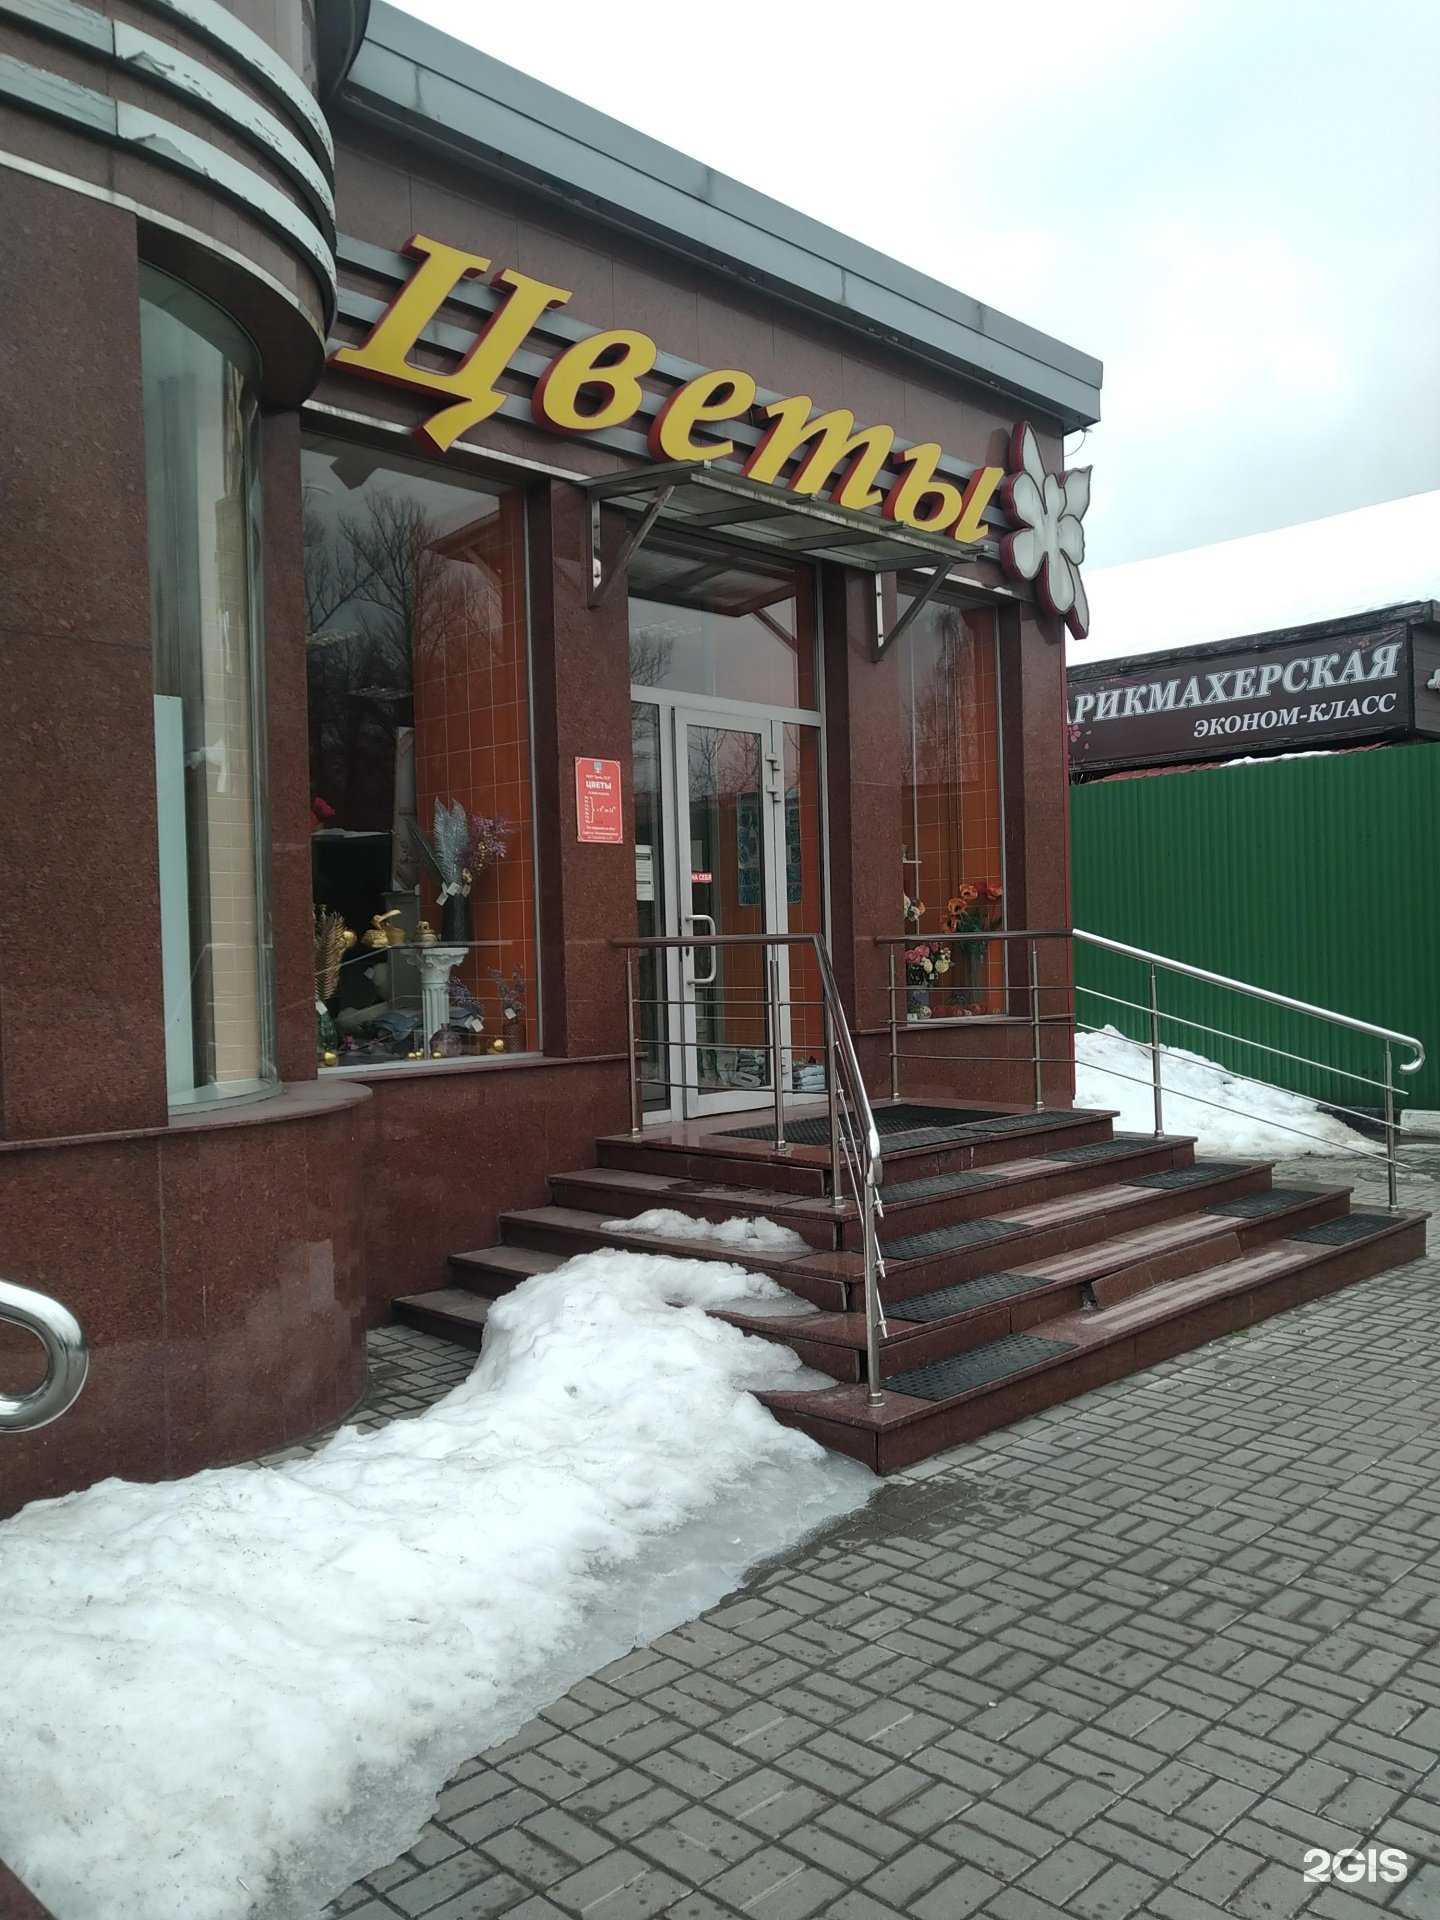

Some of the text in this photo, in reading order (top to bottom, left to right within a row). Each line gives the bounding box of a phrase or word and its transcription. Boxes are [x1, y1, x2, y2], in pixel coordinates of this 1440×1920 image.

[331, 234, 1004, 542] Цветы
[1067, 642, 1403, 725] РИКМАХЕРСКАЯ
[1194, 692, 1398, 739] ЭКОНОМ-КЛАСС
